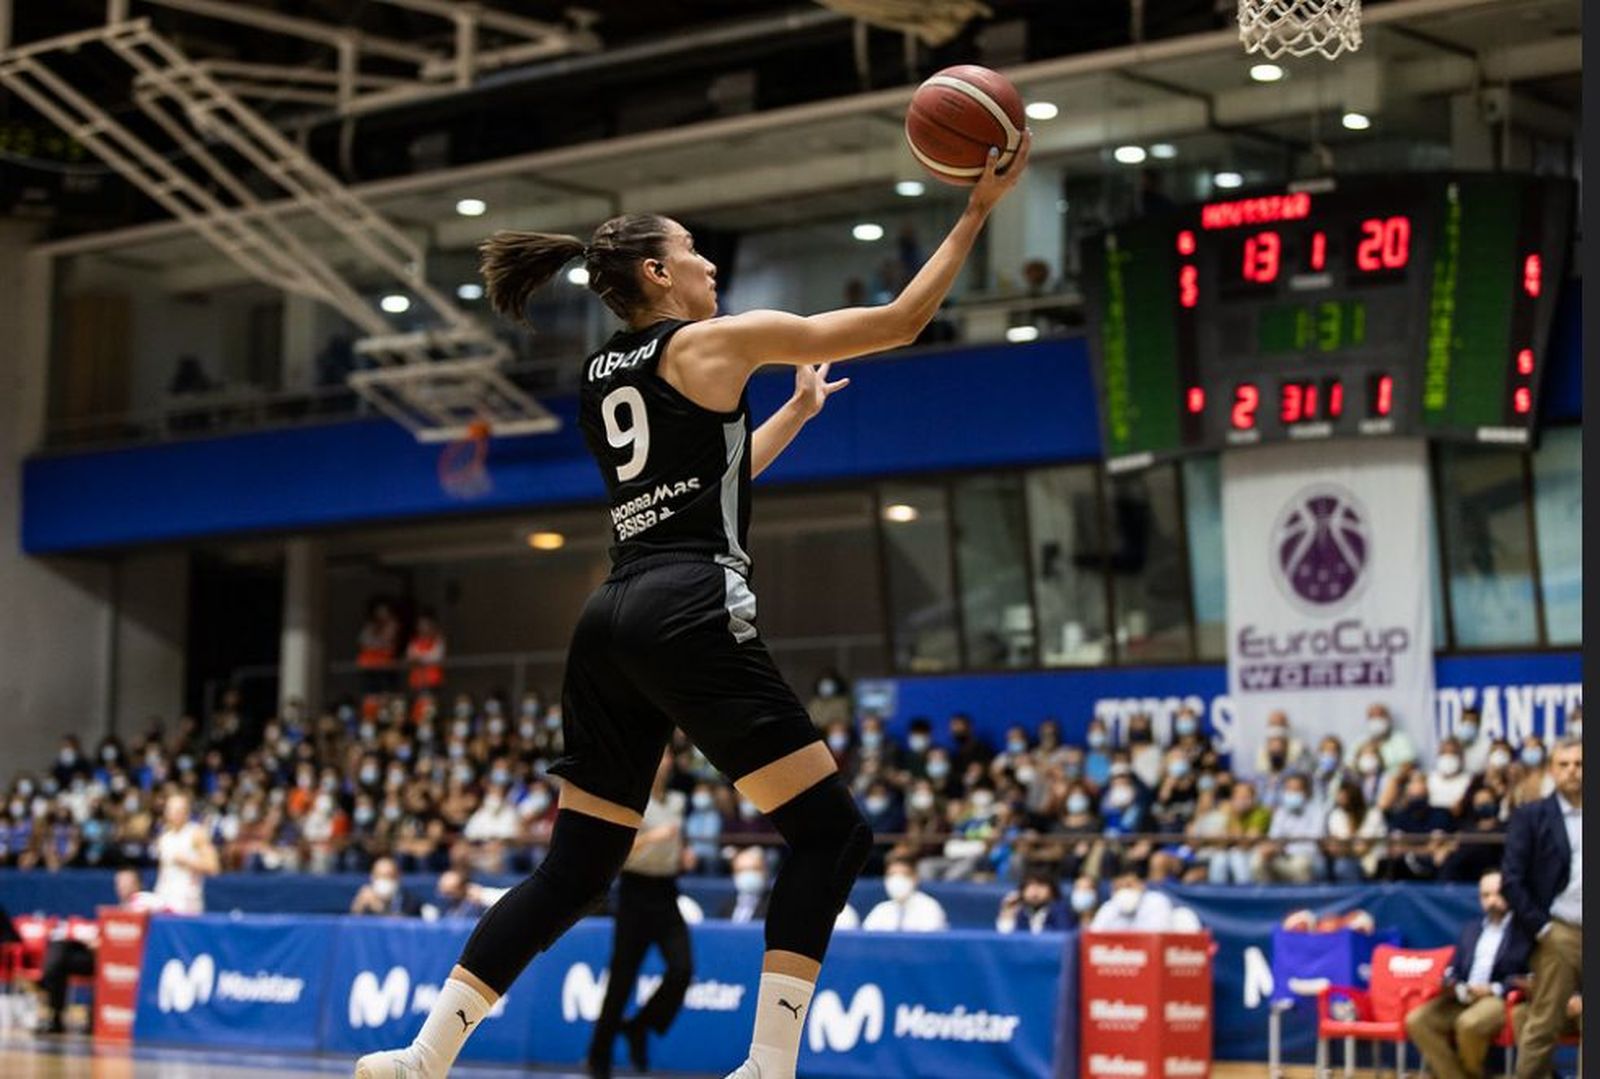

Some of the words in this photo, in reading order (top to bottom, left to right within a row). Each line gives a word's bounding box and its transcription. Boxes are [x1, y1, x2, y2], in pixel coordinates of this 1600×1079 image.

[1243, 231, 1281, 283] 13
[1311, 231, 1326, 271] 1
[1357, 215, 1410, 271] 20
[1231, 383, 1259, 429] 2
[1377, 375, 1393, 415] 1
[601, 386, 650, 482] 9
[616, 510, 658, 541] asisa
[1237, 619, 1409, 665] EuroCup
[894, 1003, 1020, 1042] Movistar
